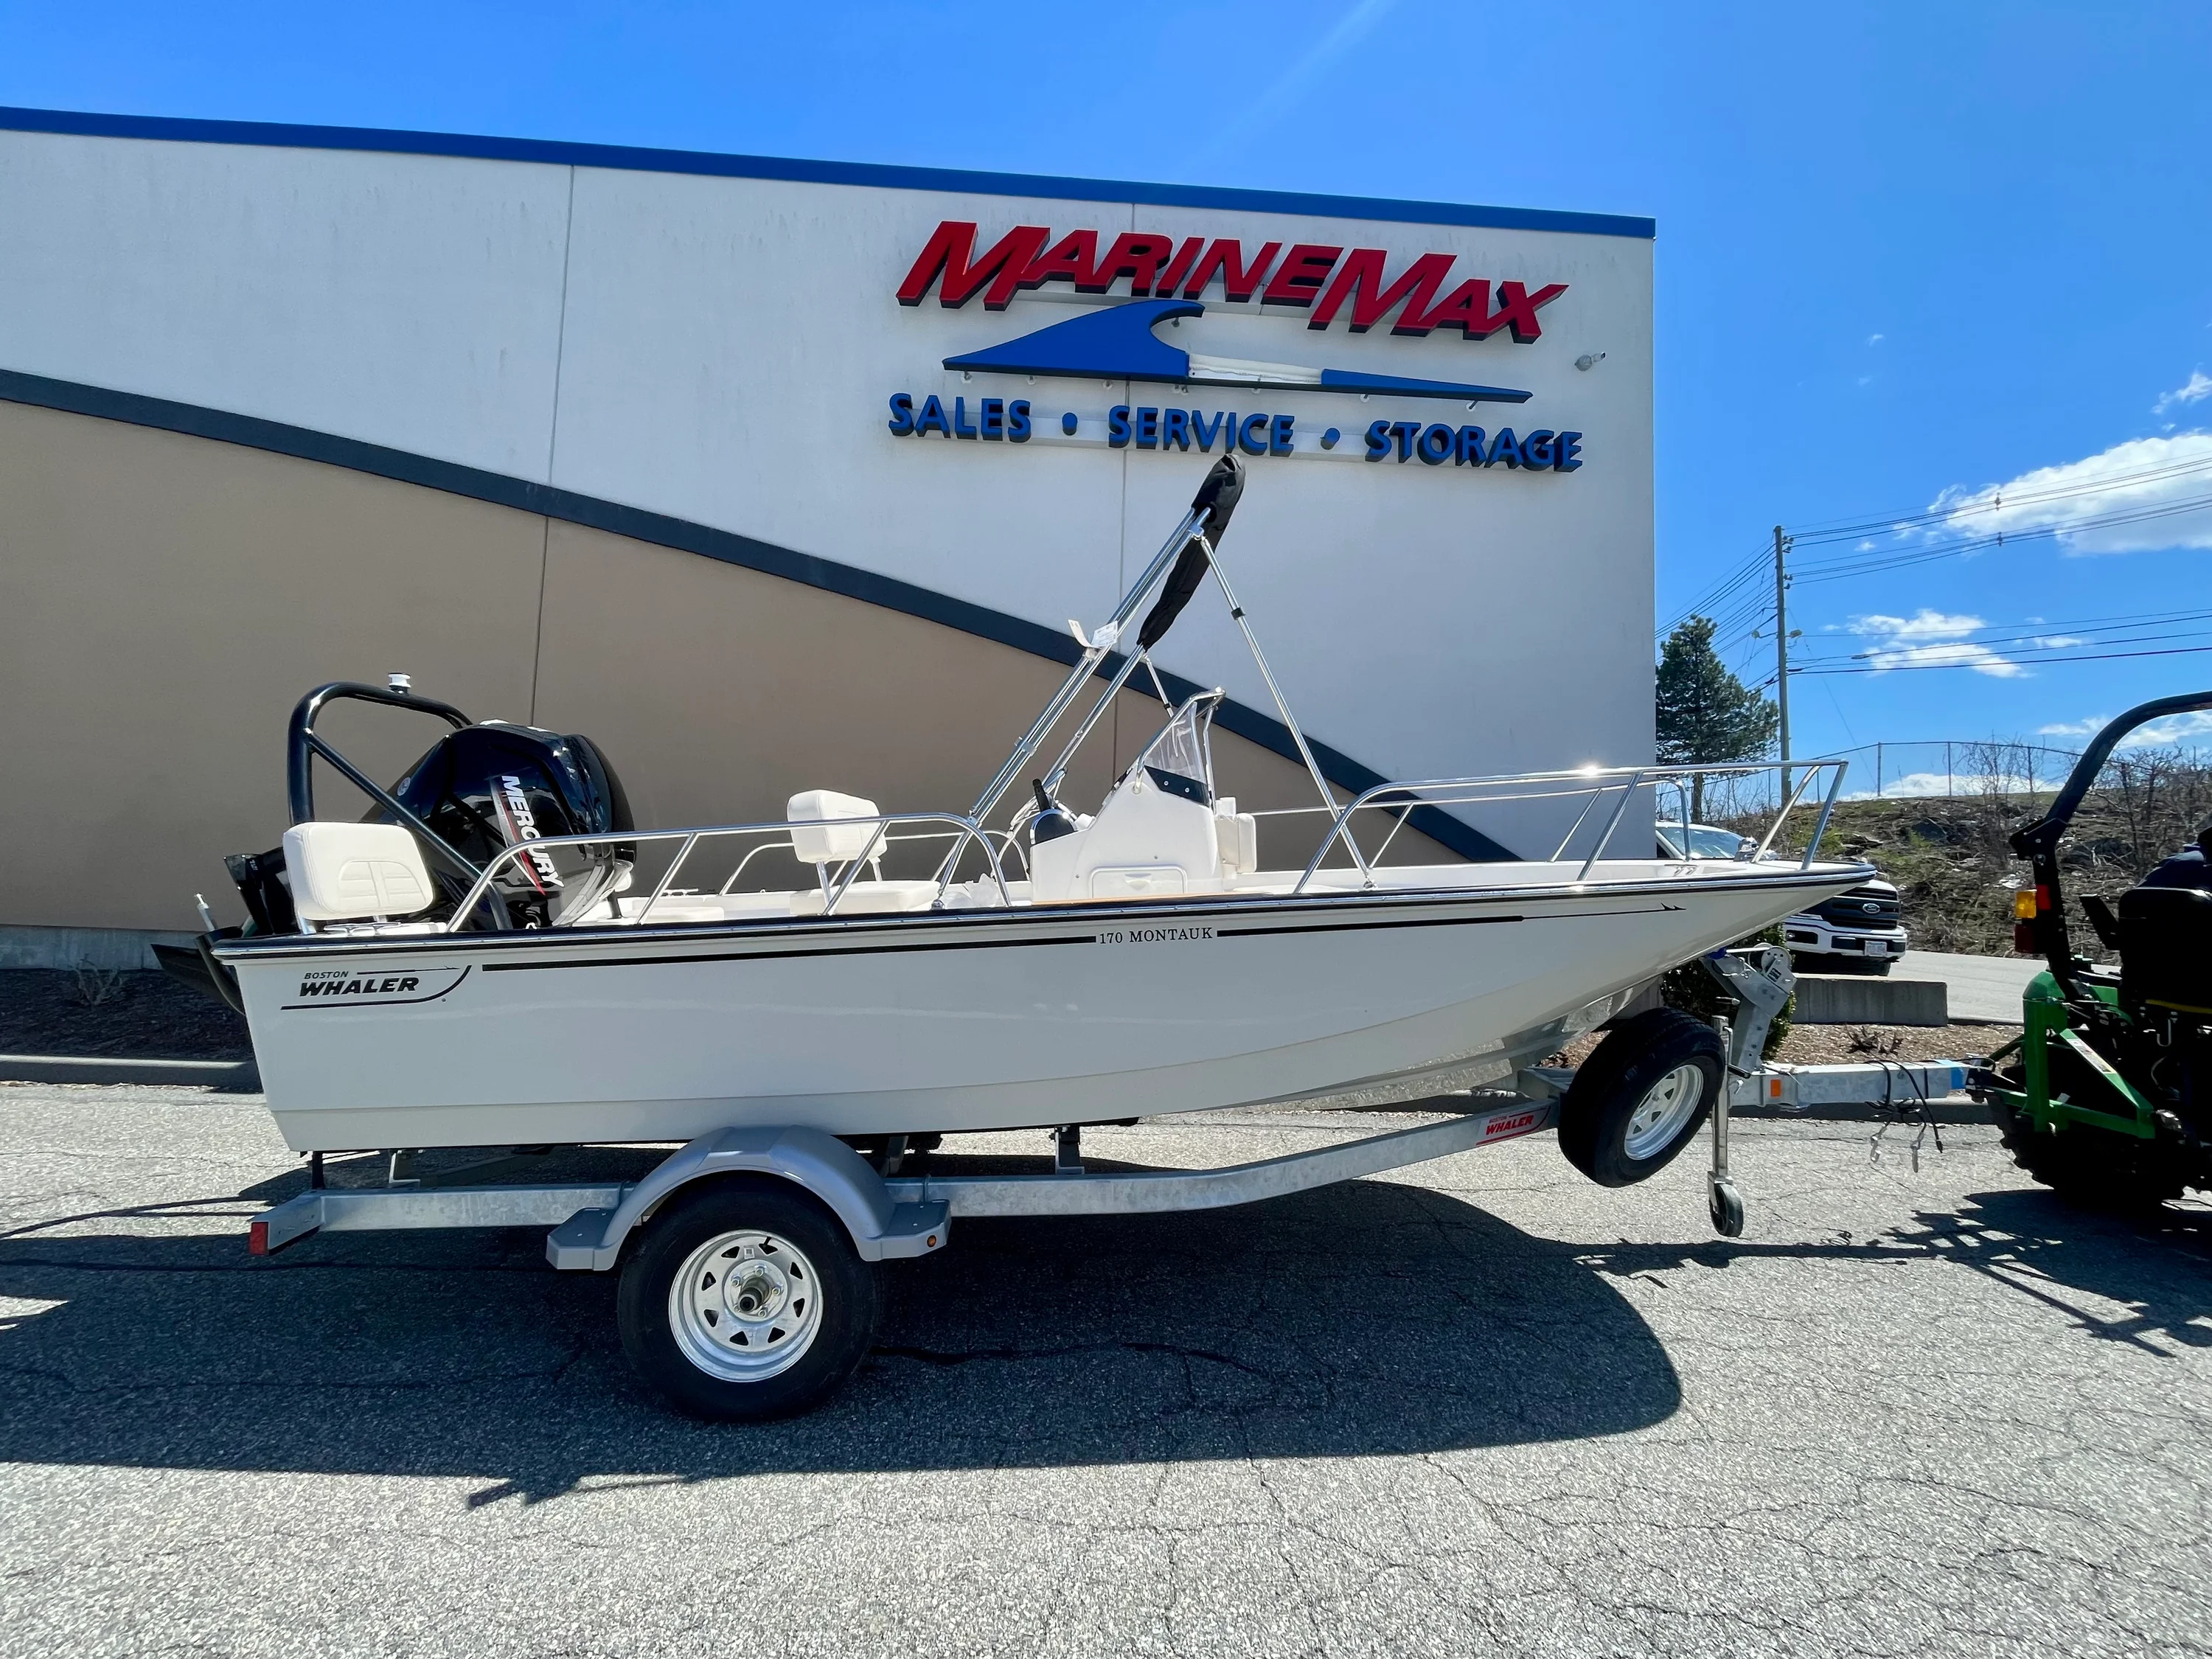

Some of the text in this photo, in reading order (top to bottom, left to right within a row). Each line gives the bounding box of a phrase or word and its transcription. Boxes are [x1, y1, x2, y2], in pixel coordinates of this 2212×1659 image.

[888, 392, 1583, 473] SALES SERVICE STORAGE
[501, 775, 565, 888] MERCURY
[1099, 927, 1213, 944] 170 MONTAUK
[304, 970, 349, 980] BOSTON
[299, 977, 420, 997] WHALER
[1486, 1115, 1534, 1135] WHALER
